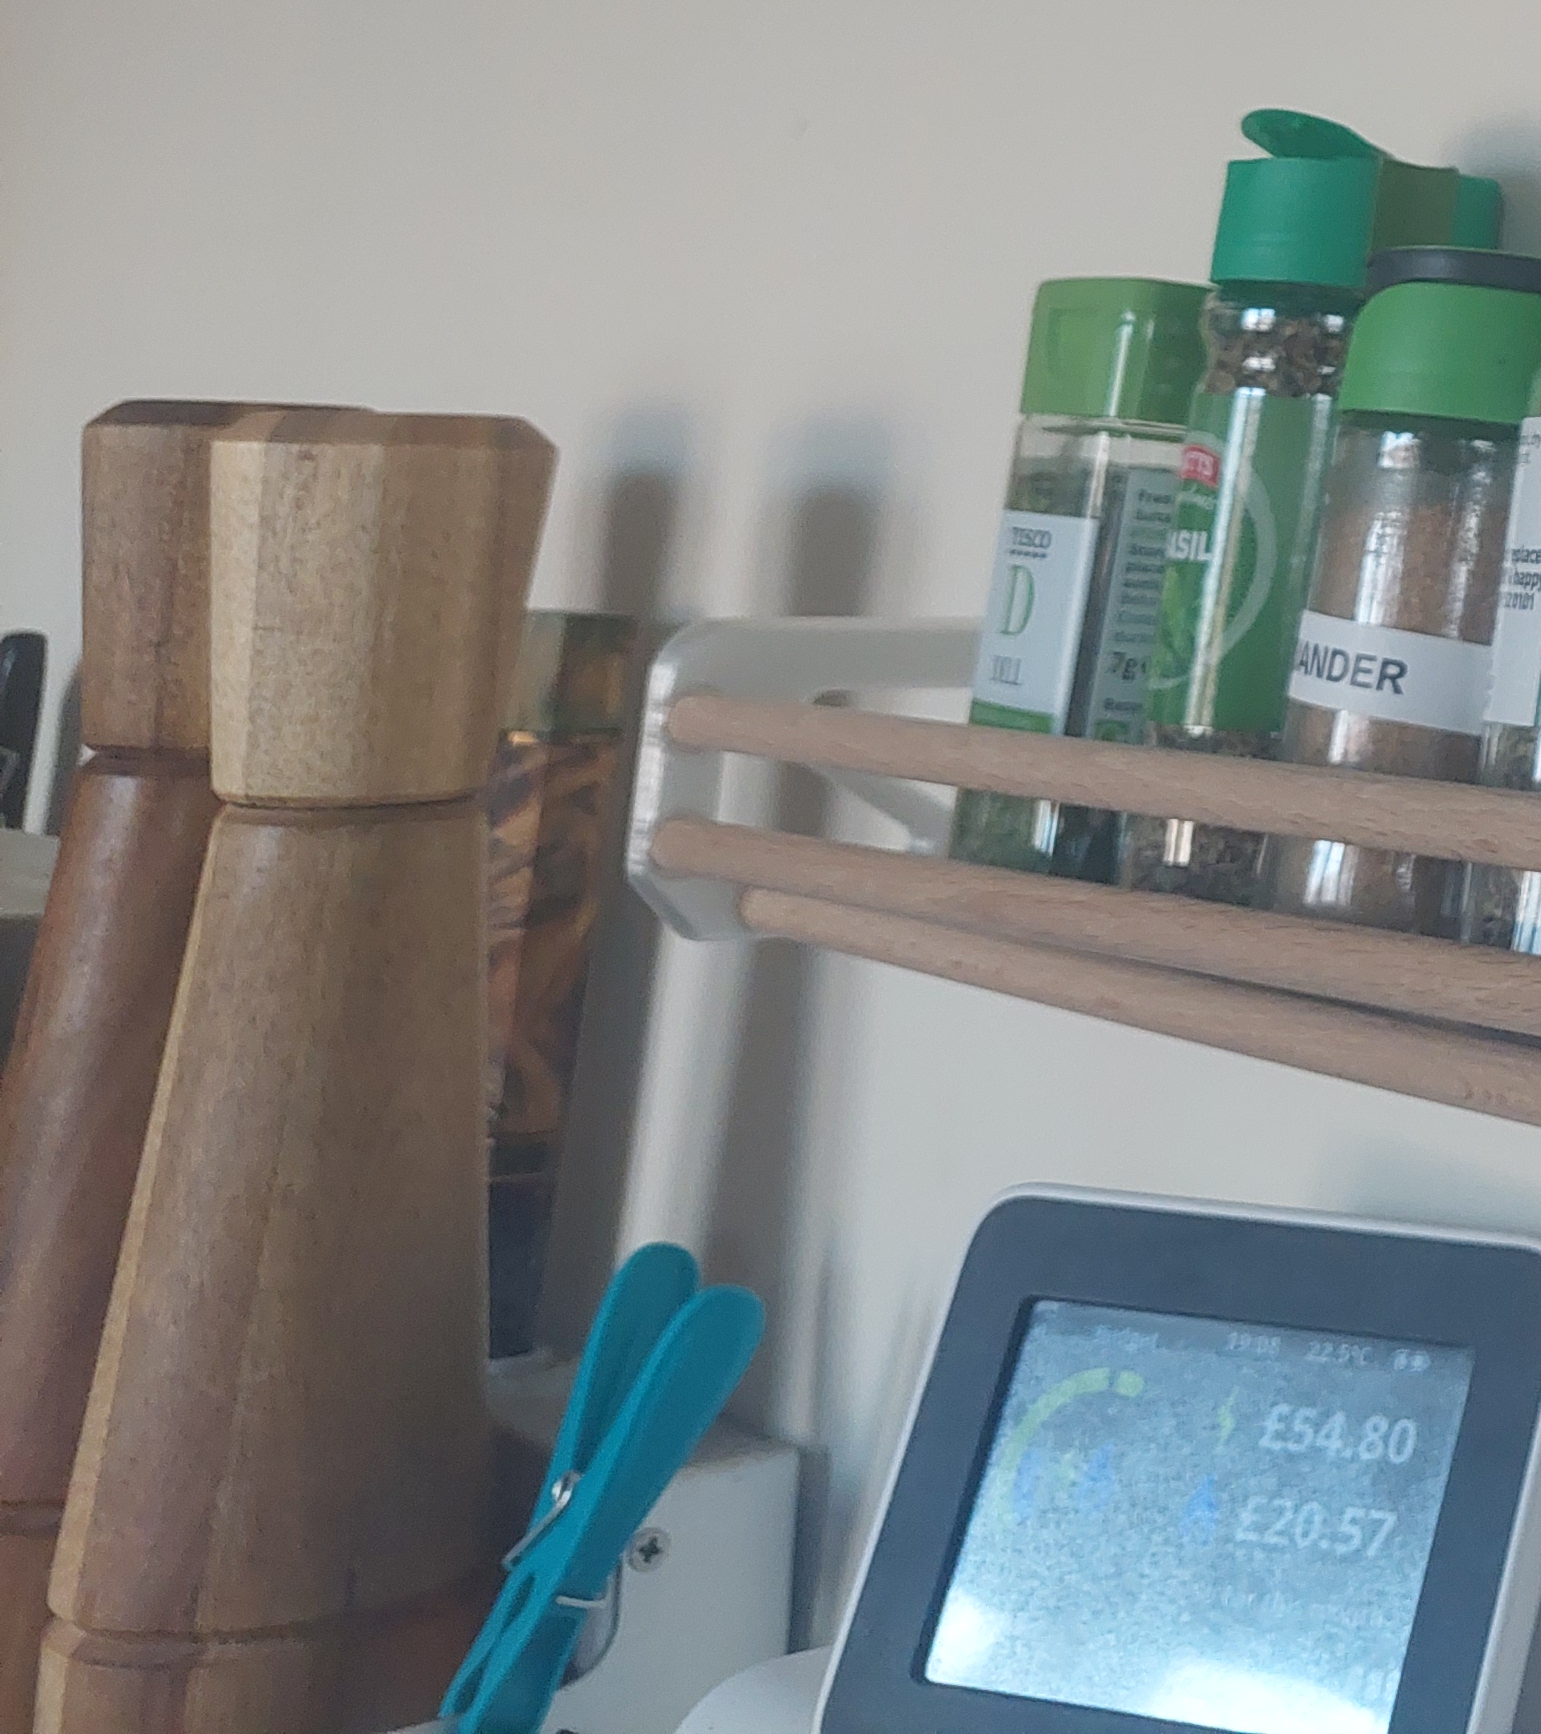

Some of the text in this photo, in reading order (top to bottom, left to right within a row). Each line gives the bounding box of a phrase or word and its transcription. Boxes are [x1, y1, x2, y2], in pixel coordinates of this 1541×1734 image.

[1000, 564, 1036, 637] D
[1298, 640, 1409, 695] ANDER
[1255, 1403, 1419, 1464] £54.80
[1235, 1496, 1400, 1559] £20.57
